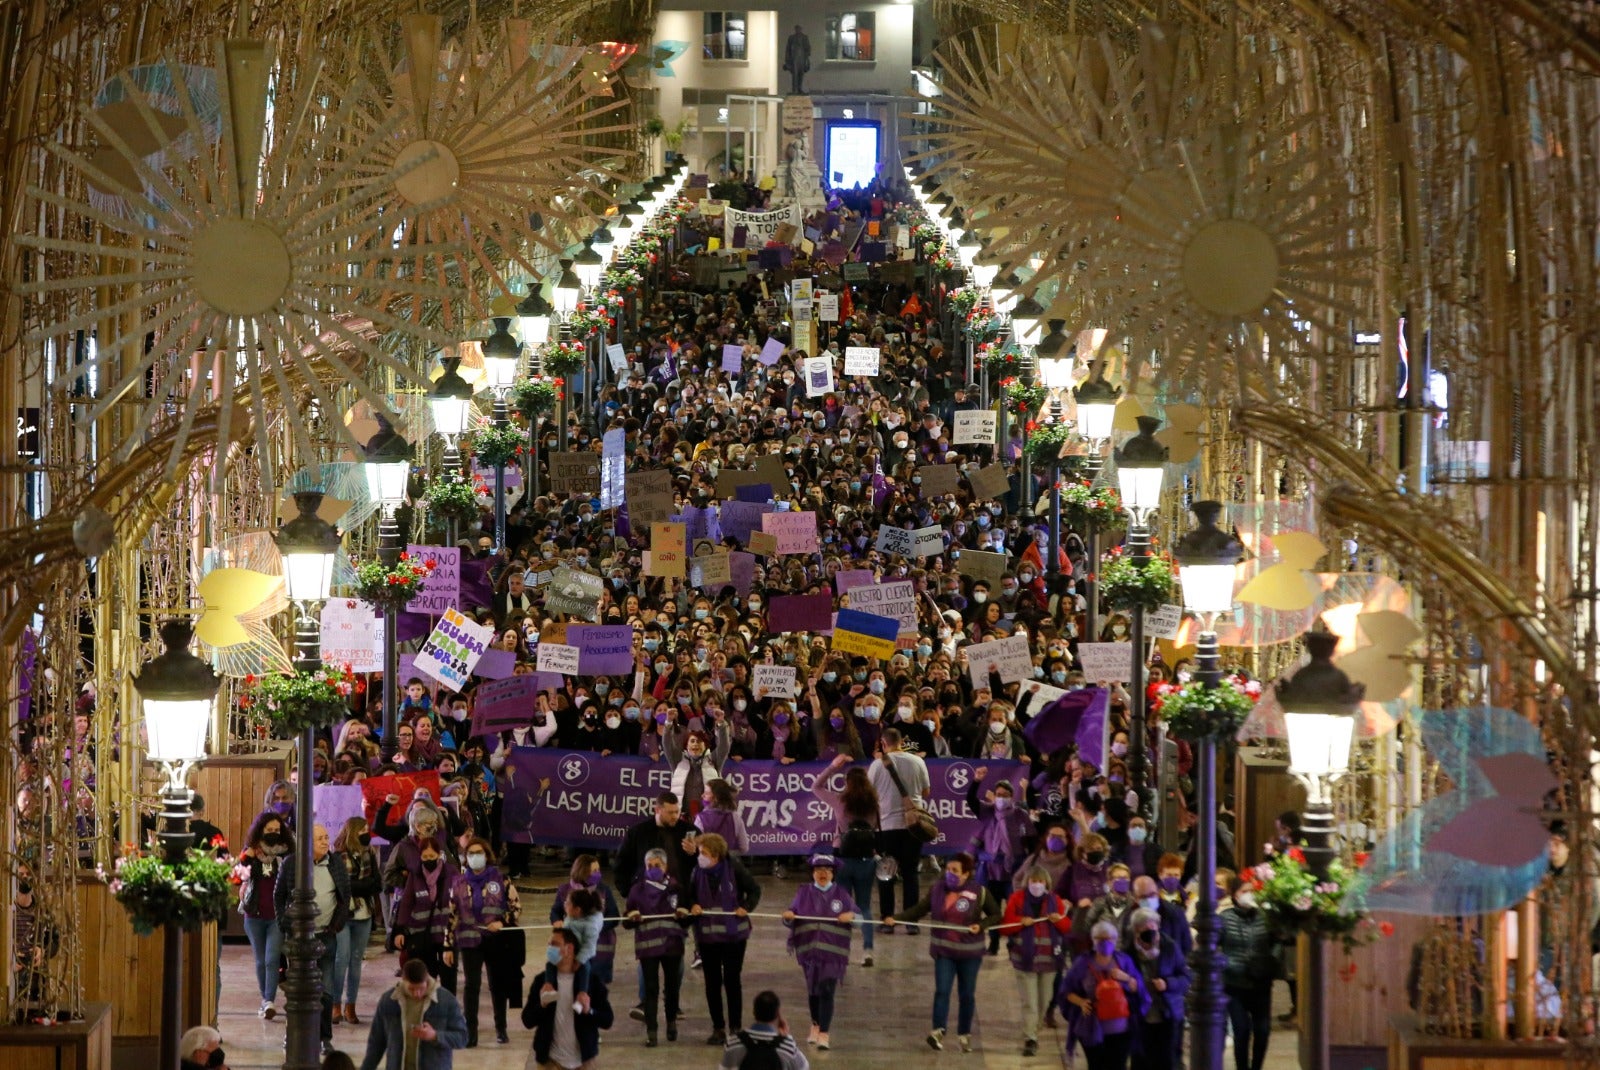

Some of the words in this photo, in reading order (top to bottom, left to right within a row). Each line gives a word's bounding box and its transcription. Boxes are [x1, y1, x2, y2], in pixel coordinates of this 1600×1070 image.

[734, 208, 791, 223] DERECHOS
[619, 767, 643, 788] EL
[749, 773, 772, 793] ES
[545, 789, 583, 812] LAS
[587, 792, 658, 817] MUJERE
[801, 831, 817, 842] de
